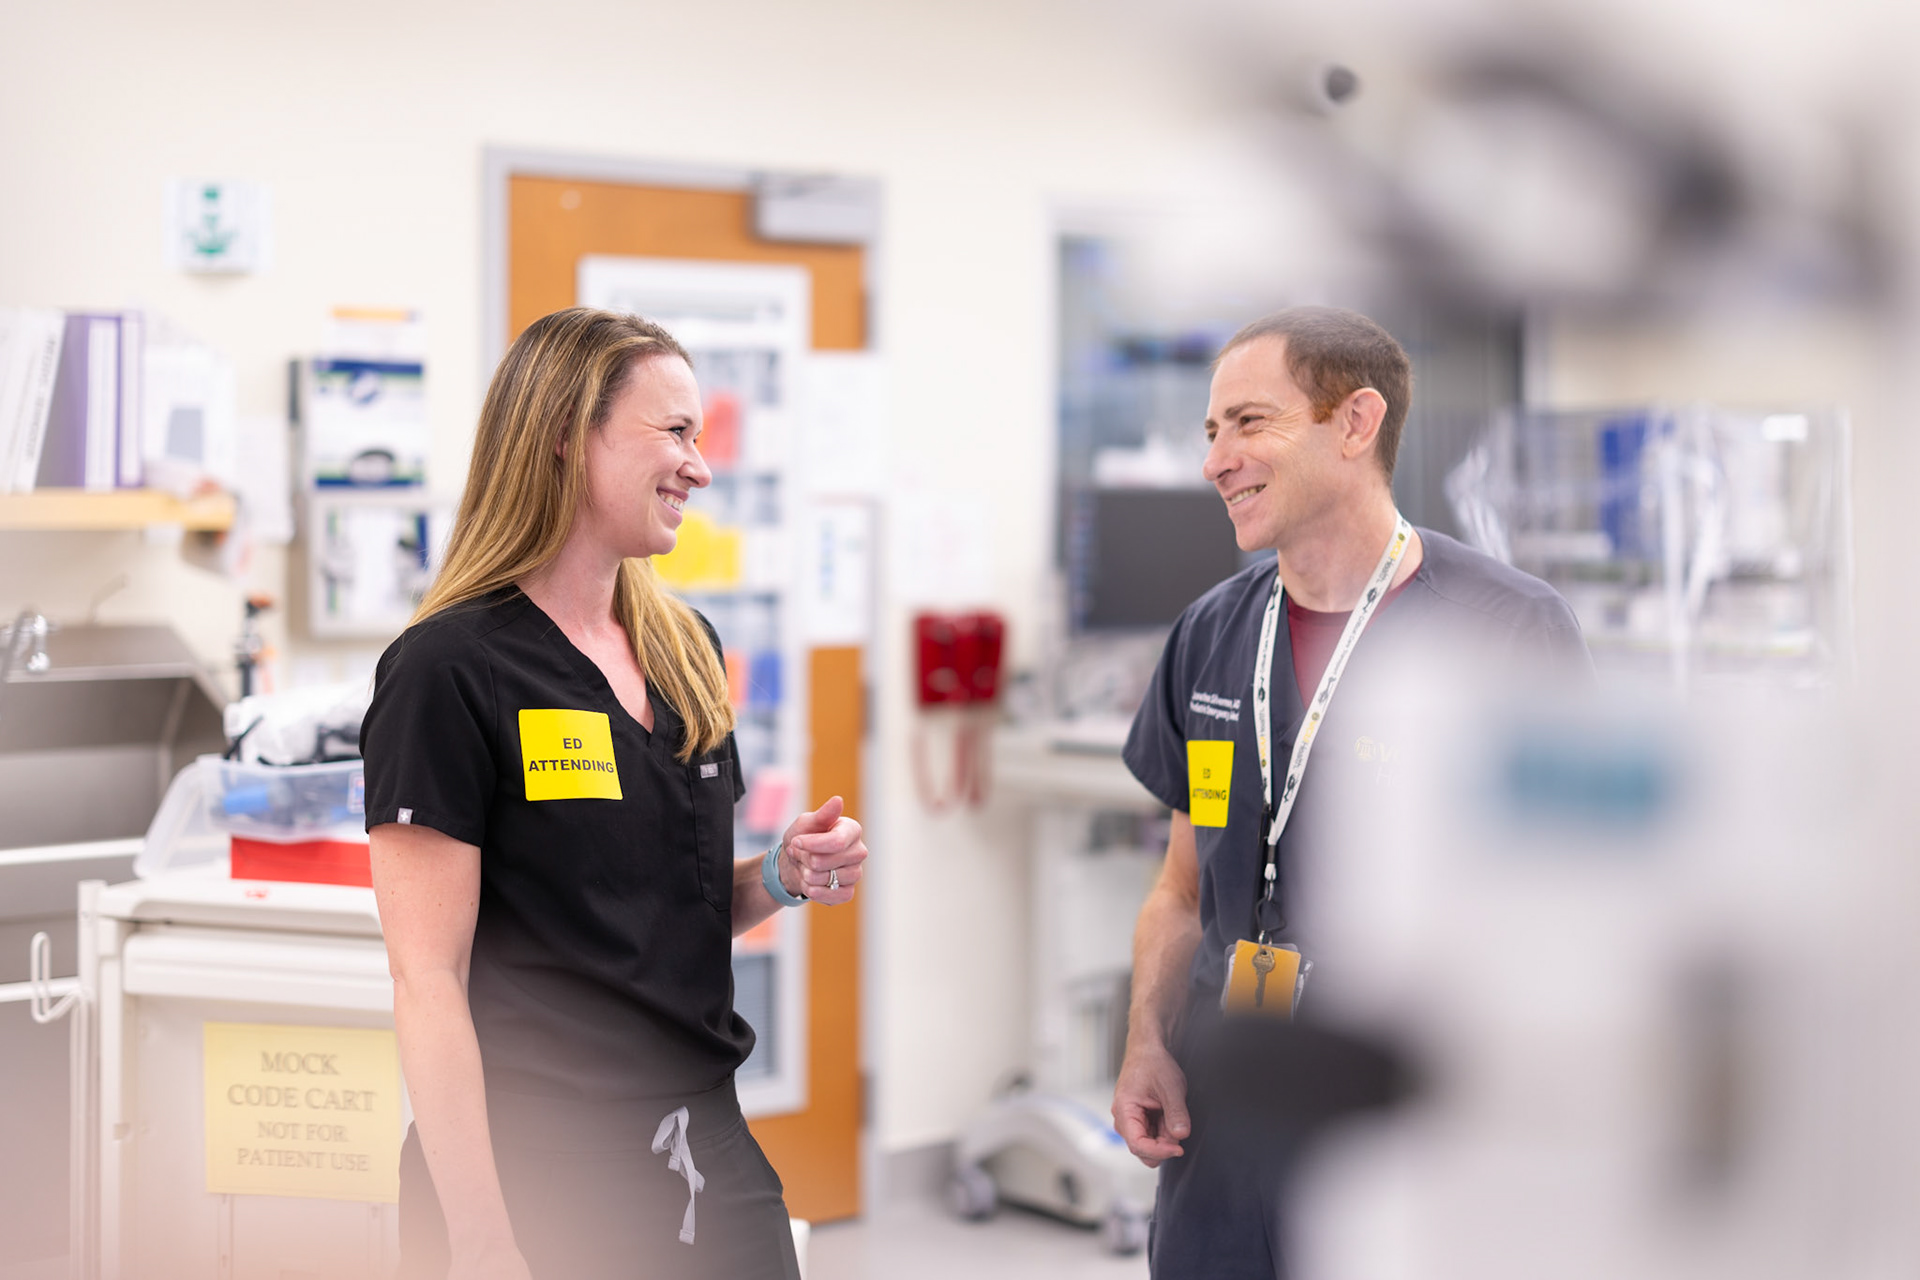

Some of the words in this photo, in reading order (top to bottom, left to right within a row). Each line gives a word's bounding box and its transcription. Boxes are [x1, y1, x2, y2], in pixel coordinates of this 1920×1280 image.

[563, 738, 583, 750] ED
[528, 759, 615, 773] ATTENDING
[1202, 768, 1211, 779] ED
[1192, 788, 1227, 800] ATTENDING
[260, 1051, 340, 1075] MOCK
[227, 1084, 299, 1109] CODE
[304, 1088, 378, 1112] CART
[257, 1121, 301, 1141] NOT
[306, 1124, 349, 1143] FOR
[236, 1147, 326, 1170] PATIENT
[330, 1153, 370, 1172] USE
